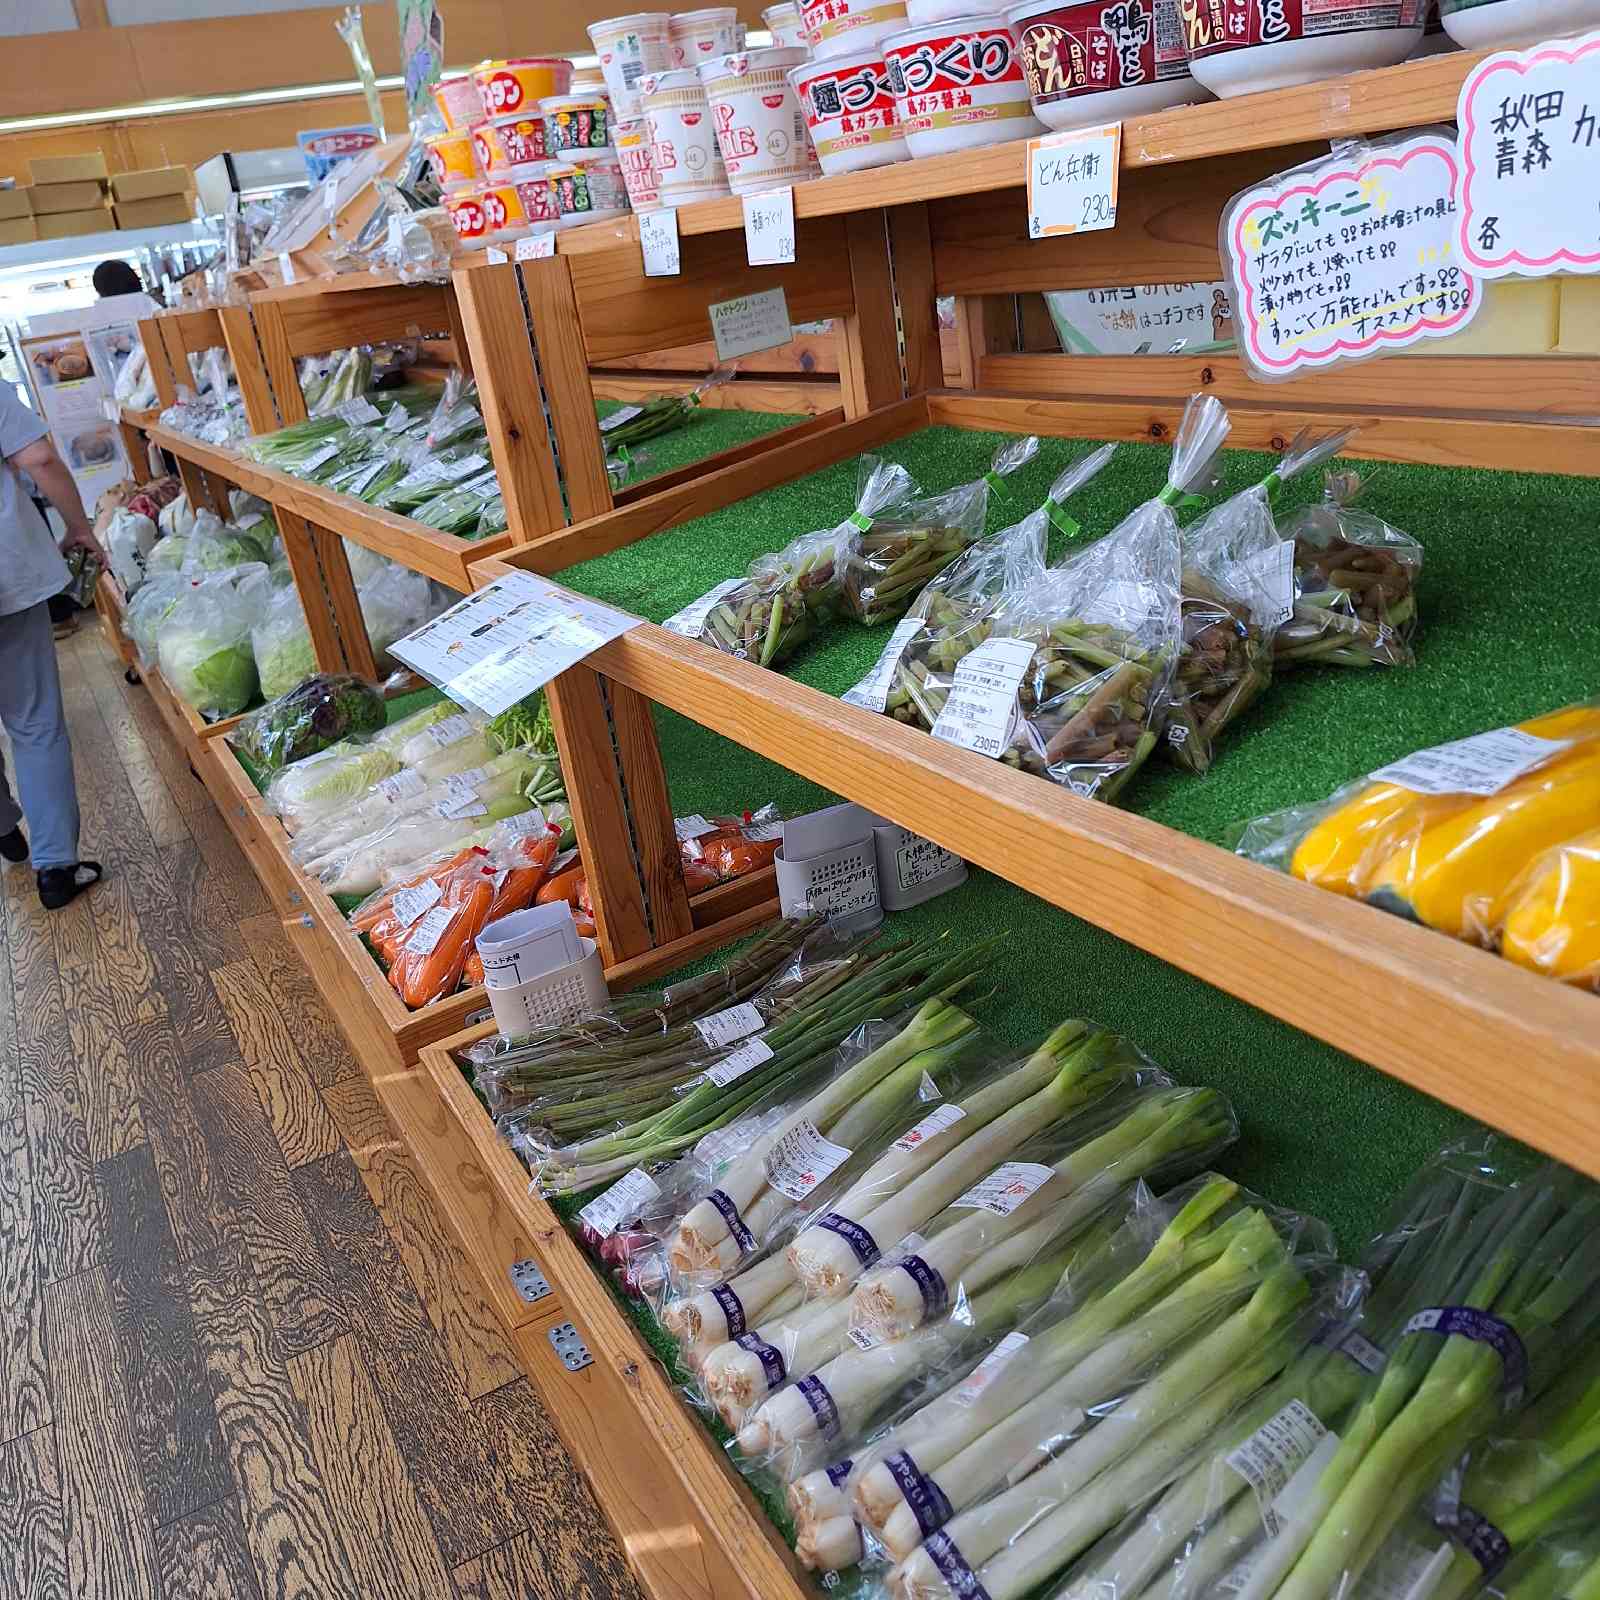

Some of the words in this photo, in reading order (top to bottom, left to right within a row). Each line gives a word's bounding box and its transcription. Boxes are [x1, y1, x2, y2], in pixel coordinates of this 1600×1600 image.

[1070, 43, 1086, 85] 日清の
[1091, 35, 1109, 81] そば
[1102, 1, 1150, 85] 鴨だし
[1489, 90, 1564, 135] 秋田
[1039, 152, 1101, 187] どん兵衛
[1494, 128, 1552, 180] 青森
[1032, 216, 1042, 235] 各
[1080, 193, 1116, 227] 230円
[1257, 190, 1371, 247] ズッキーニ
[1477, 216, 1501, 251] 各
[972, 735, 1001, 755] 230円
